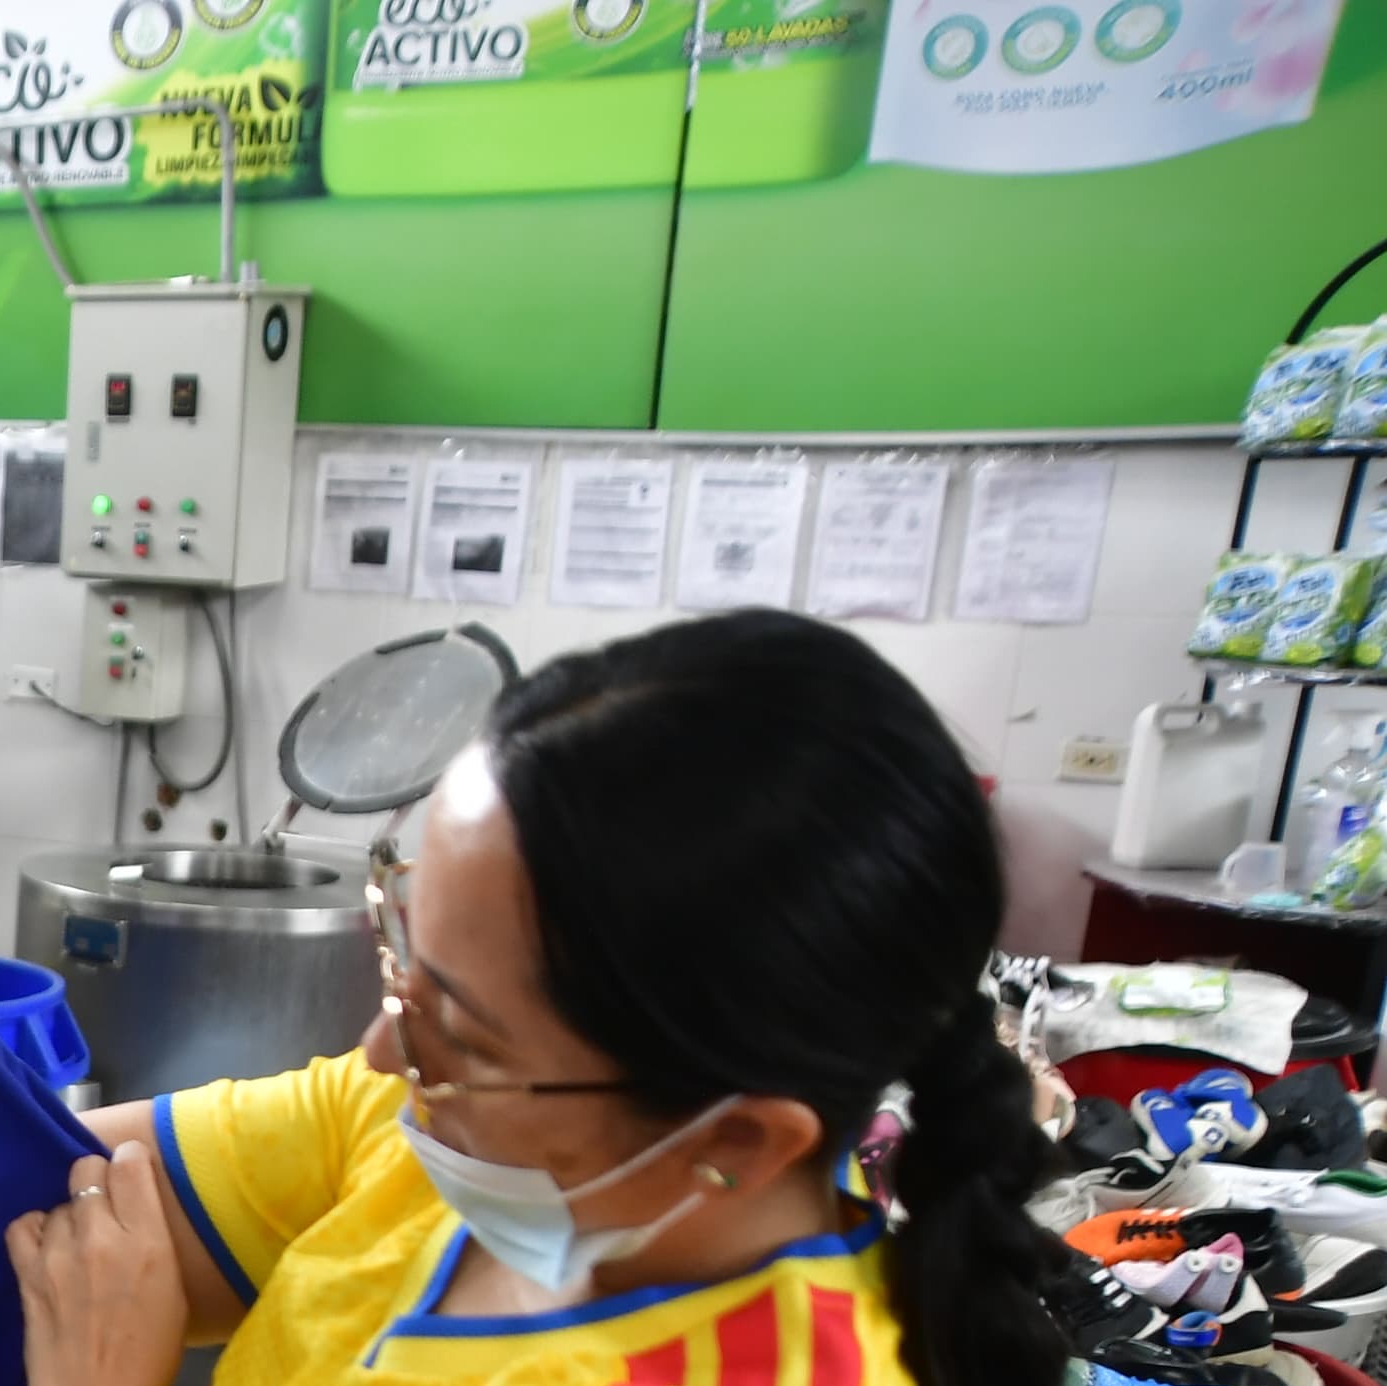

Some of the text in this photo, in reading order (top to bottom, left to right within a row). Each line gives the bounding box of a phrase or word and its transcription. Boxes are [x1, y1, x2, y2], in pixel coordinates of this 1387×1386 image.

[365, 25, 524, 67] ACTIVO
[1155, 63, 1253, 99] 400ml
[160, 85, 252, 118] NUEVA
